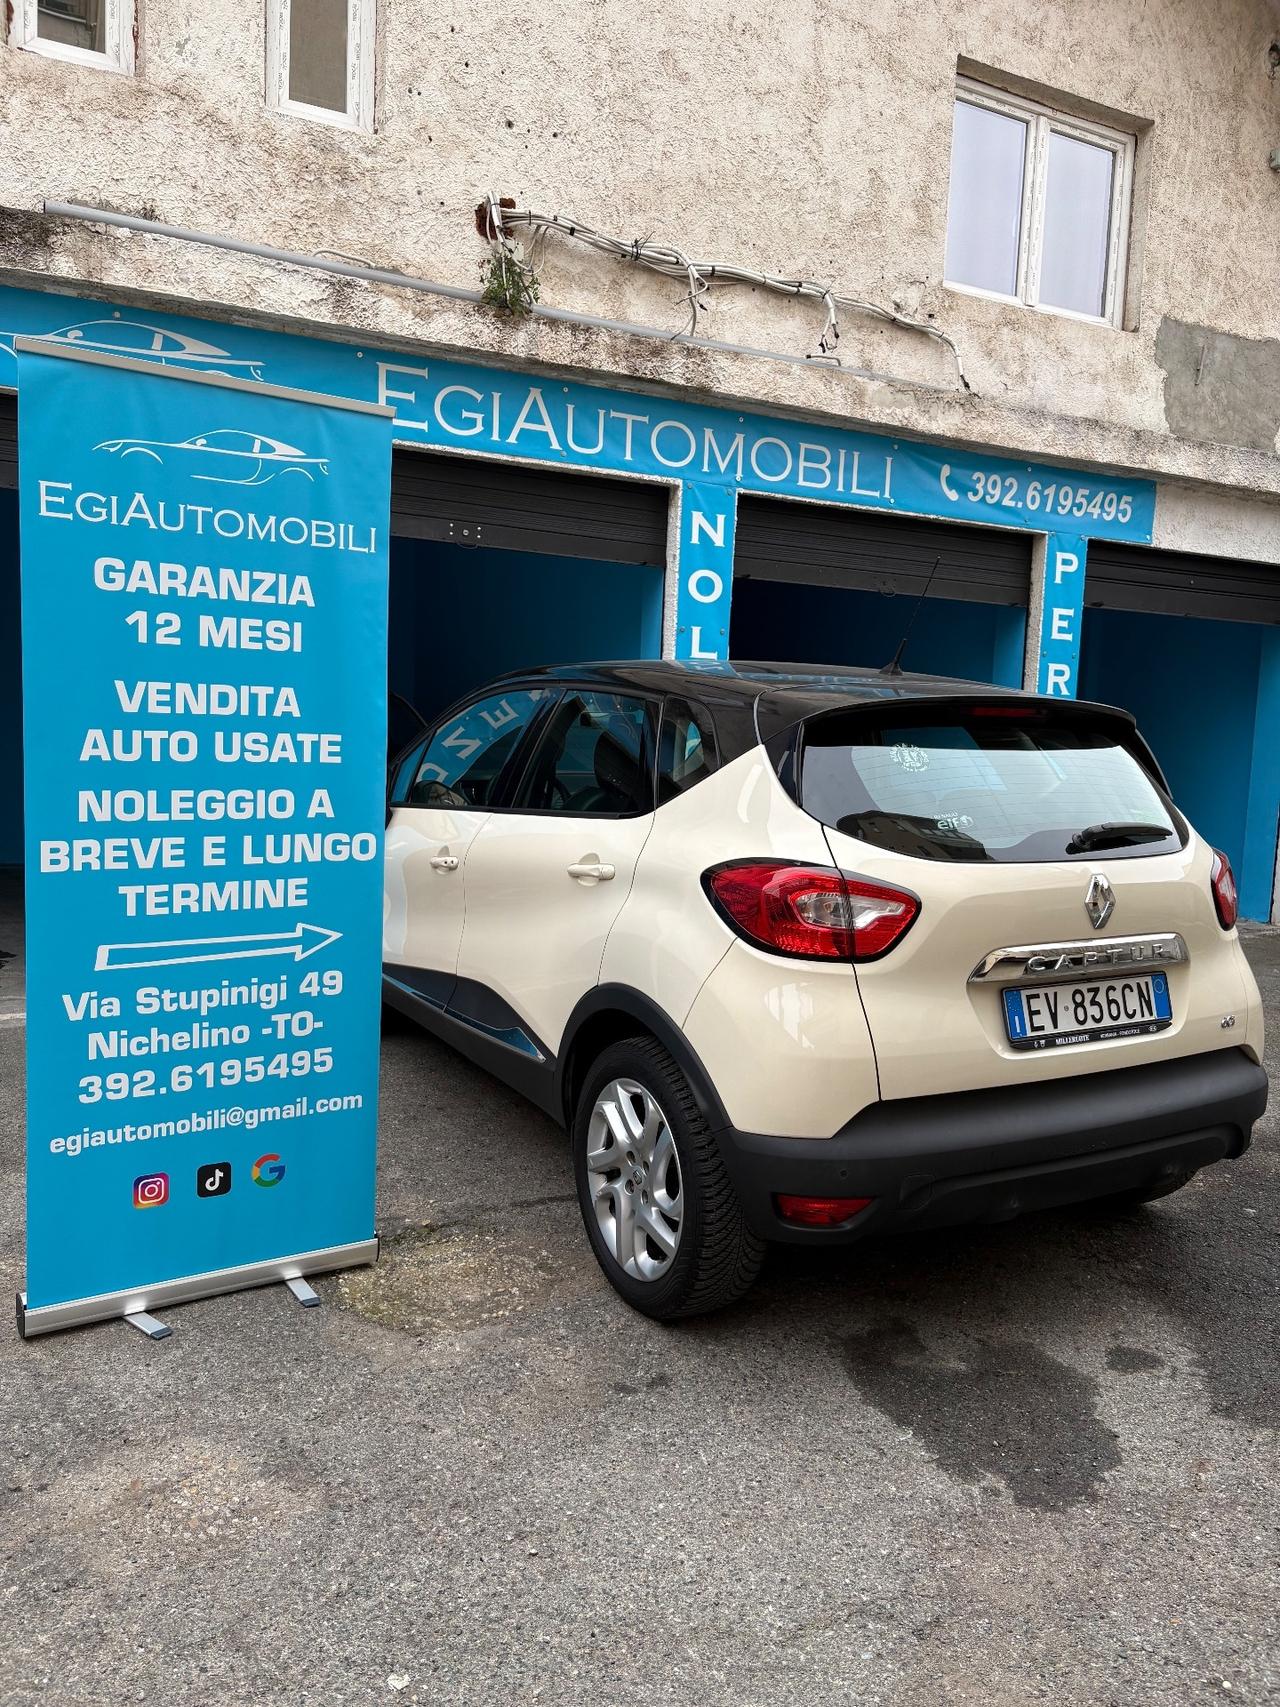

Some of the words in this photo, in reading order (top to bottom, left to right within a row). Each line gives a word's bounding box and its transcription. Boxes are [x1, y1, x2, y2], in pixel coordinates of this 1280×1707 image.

[968, 471, 1133, 523] 392.6195495
[95, 558, 315, 607] GARANZIA
[126, 611, 181, 645] 12
[200, 616, 302, 652] MESI
[1046, 552, 1079, 696] PER
[115, 680, 300, 717] VENDITA
[80, 729, 198, 762] AUTO
[215, 732, 341, 763] USATE
[79, 790, 294, 822] NOLEGGIO
[308, 789, 334, 818] A
[40, 838, 185, 873] BREVE
[204, 836, 226, 866] E
[244, 832, 376, 864] LUNGO
[119, 878, 308, 916] TERMINE
[1027, 944, 1164, 970] CAPTUR
[62, 992, 120, 1021] Via
[137, 976, 287, 1015] Stupinigi
[300, 971, 343, 996] 49
[1025, 992, 1059, 1032] EV
[1072, 981, 1154, 1026] 836CN
[88, 1022, 250, 1060] Nichelino
[262, 1011, 323, 1038] -TO-
[79, 1047, 334, 1103] 392.6195495
[50, 1093, 363, 1156] egiautomobili@gmail.com
